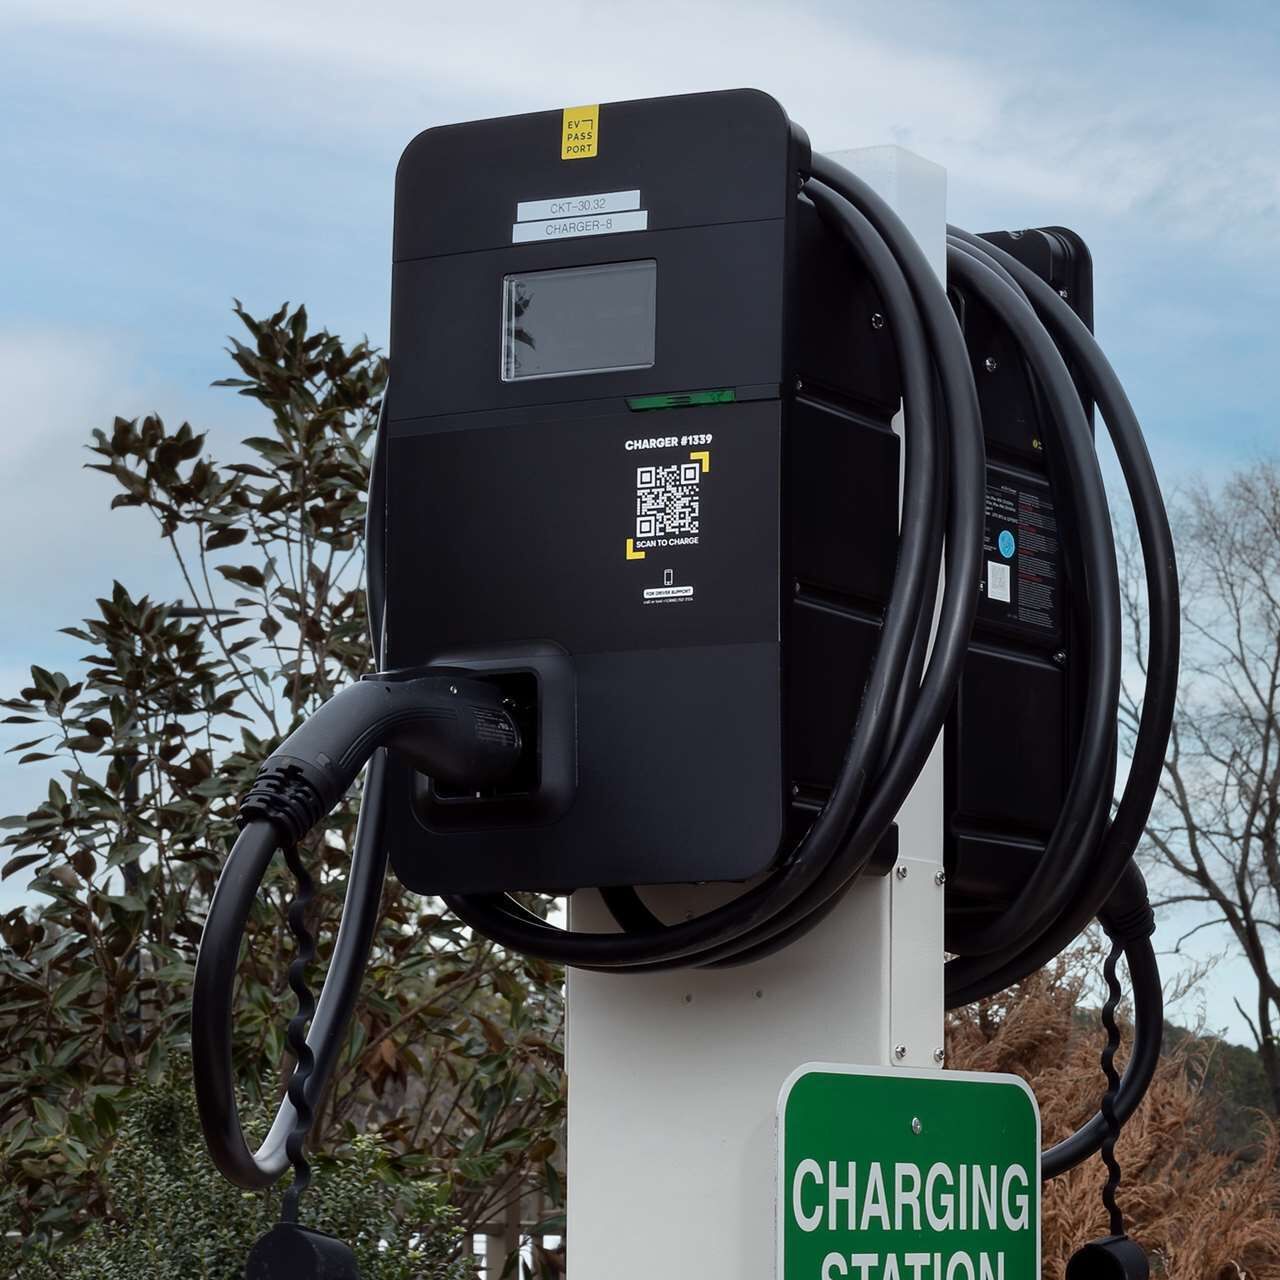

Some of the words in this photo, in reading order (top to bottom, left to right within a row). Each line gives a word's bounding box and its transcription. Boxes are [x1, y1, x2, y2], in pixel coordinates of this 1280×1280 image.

[568, 120, 580, 129] EV
[567, 132, 593, 141] PASS
[566, 144, 592, 153] PORT
[545, 218, 612, 236] CHARGER-8
[625, 436, 678, 450] CHARGER
[680, 434, 713, 446] #1339
[636, 539, 656, 548] SCAN
[668, 537, 699, 546] CHARGE
[793, 1158, 1029, 1232] CHARGING
